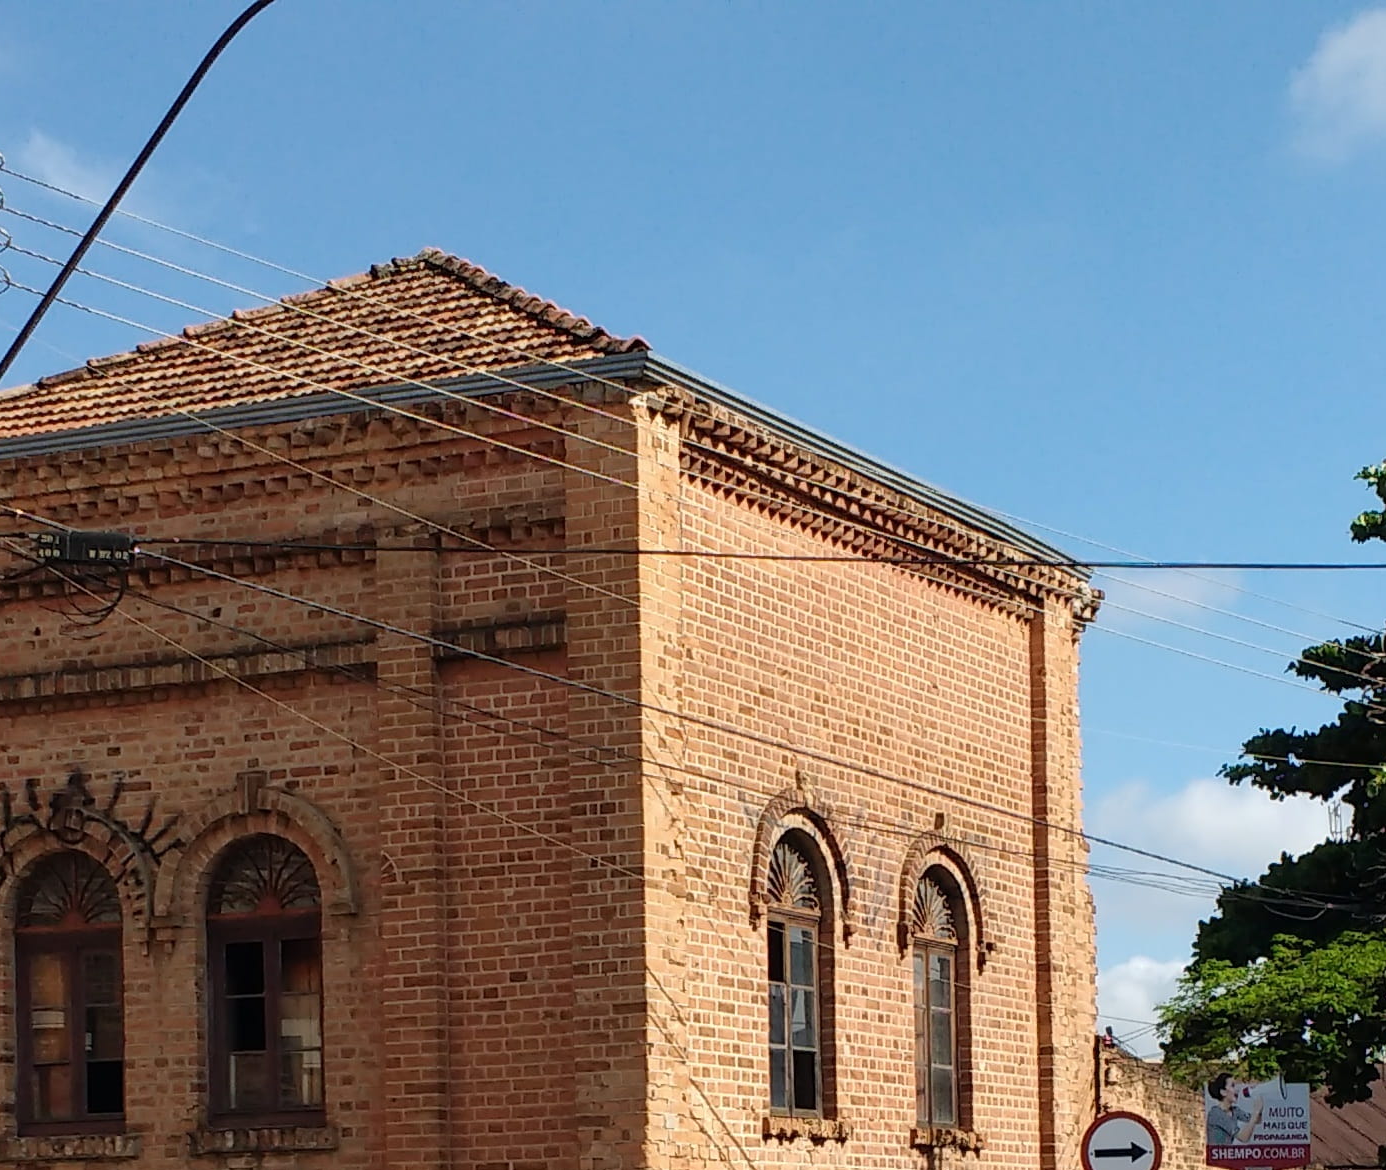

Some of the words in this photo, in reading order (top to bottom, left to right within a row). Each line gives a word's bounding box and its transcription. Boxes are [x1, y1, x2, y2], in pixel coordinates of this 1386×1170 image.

[1268, 1107, 1305, 1118] MUITO
[1263, 1121, 1286, 1130] MAIS
[1287, 1121, 1308, 1130] QUE
[1253, 1133, 1309, 1142] PROPAGANDA
[1211, 1147, 1306, 1160] SHEMPO.COM.BR
